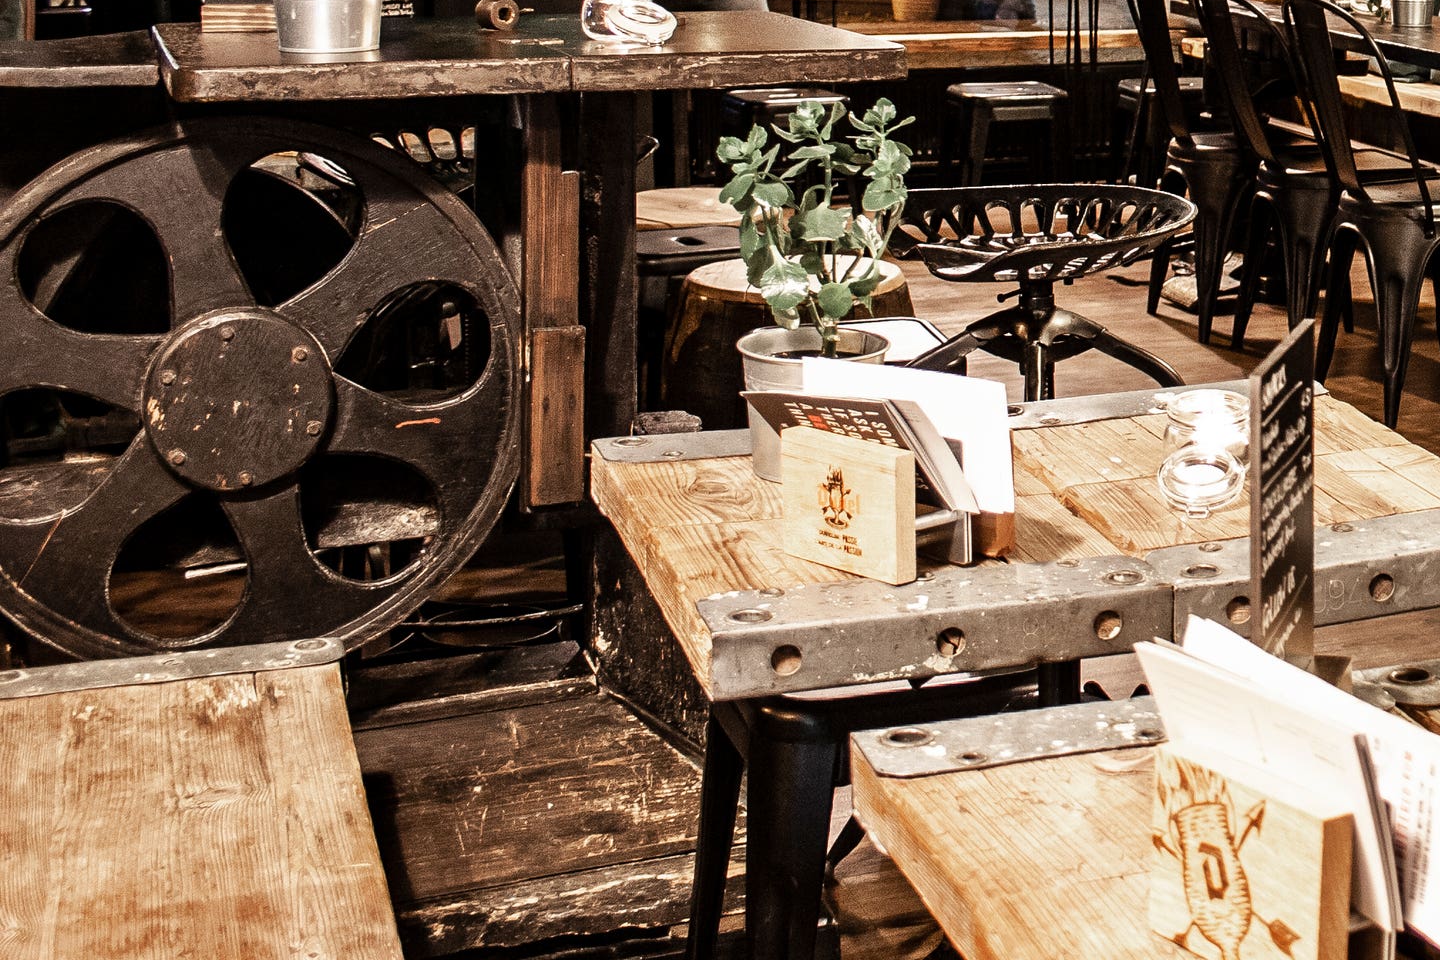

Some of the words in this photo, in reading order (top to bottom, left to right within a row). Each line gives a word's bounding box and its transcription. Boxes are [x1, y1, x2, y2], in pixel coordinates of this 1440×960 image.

[783, 401, 814, 427] THIN
[807, 414, 829, 430] BE
[816, 406, 847, 436] THER
[847, 408, 875, 433] ASK
[842, 424, 864, 439] SO
[870, 421, 900, 447] SOM
